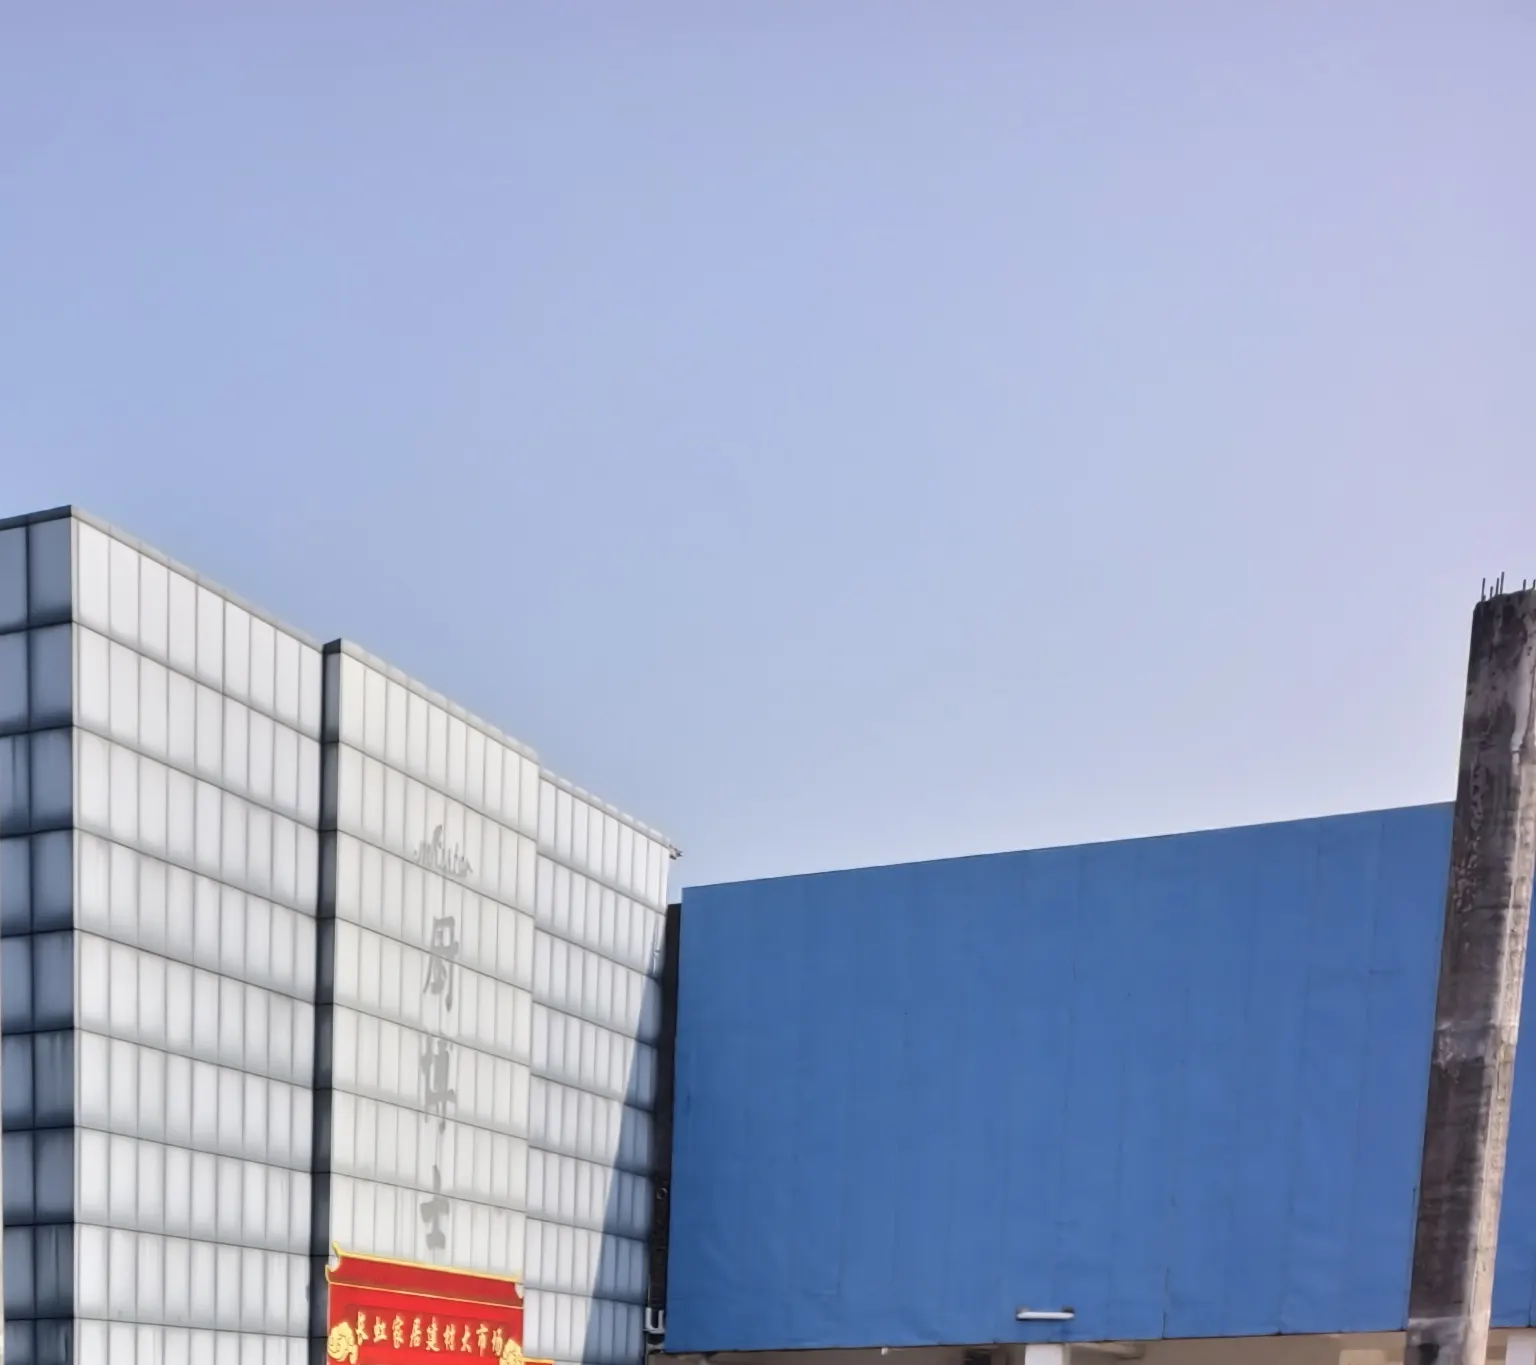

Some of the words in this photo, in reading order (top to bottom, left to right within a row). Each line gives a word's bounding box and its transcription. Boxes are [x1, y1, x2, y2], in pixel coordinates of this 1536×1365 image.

[355, 1311, 504, 1357] 长虹家居建材大市场
